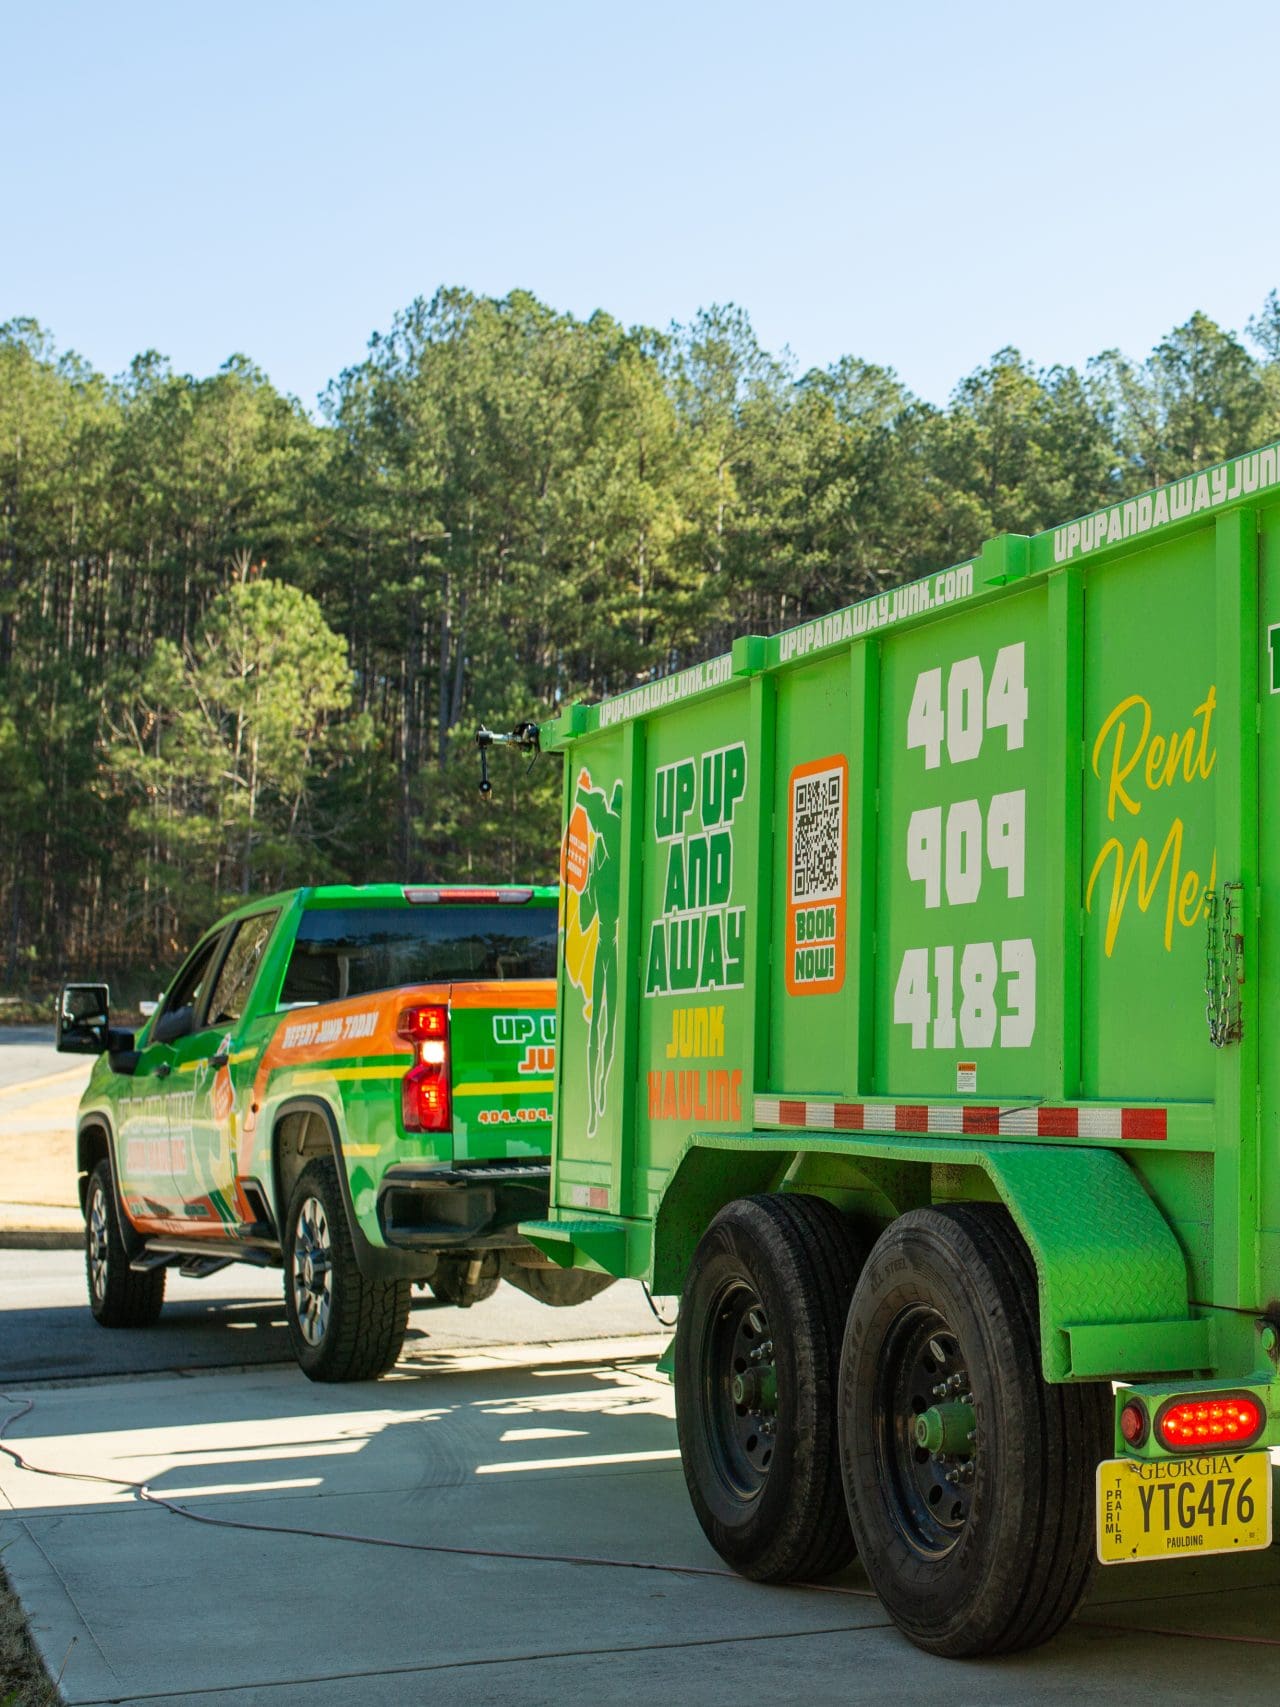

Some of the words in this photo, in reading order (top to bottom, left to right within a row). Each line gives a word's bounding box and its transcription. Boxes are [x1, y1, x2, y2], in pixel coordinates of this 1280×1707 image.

[907, 641, 1029, 770] 404
[1092, 685, 1216, 821] Rent
[655, 757, 696, 843] UP
[702, 741, 748, 832] UP
[662, 826, 733, 918] AND
[907, 789, 1027, 908] 909
[644, 905, 746, 998] AWAY
[795, 904, 836, 945] BOOK
[794, 945, 836, 984] NOW!
[893, 938, 1036, 1050] 4183
[492, 1015, 536, 1044] UP
[540, 1015, 556, 1043] U
[666, 1005, 724, 1059] JUNK
[518, 1046, 555, 1074] JU
[647, 1069, 743, 1122] HAULING
[1139, 1456, 1233, 1481] GEORGIA
[1105, 1490, 1114, 1534] PERM
[1114, 1478, 1123, 1544] TRAILR
[1138, 1477, 1255, 1533] YTG476
[1166, 1534, 1204, 1549] PAULDING
